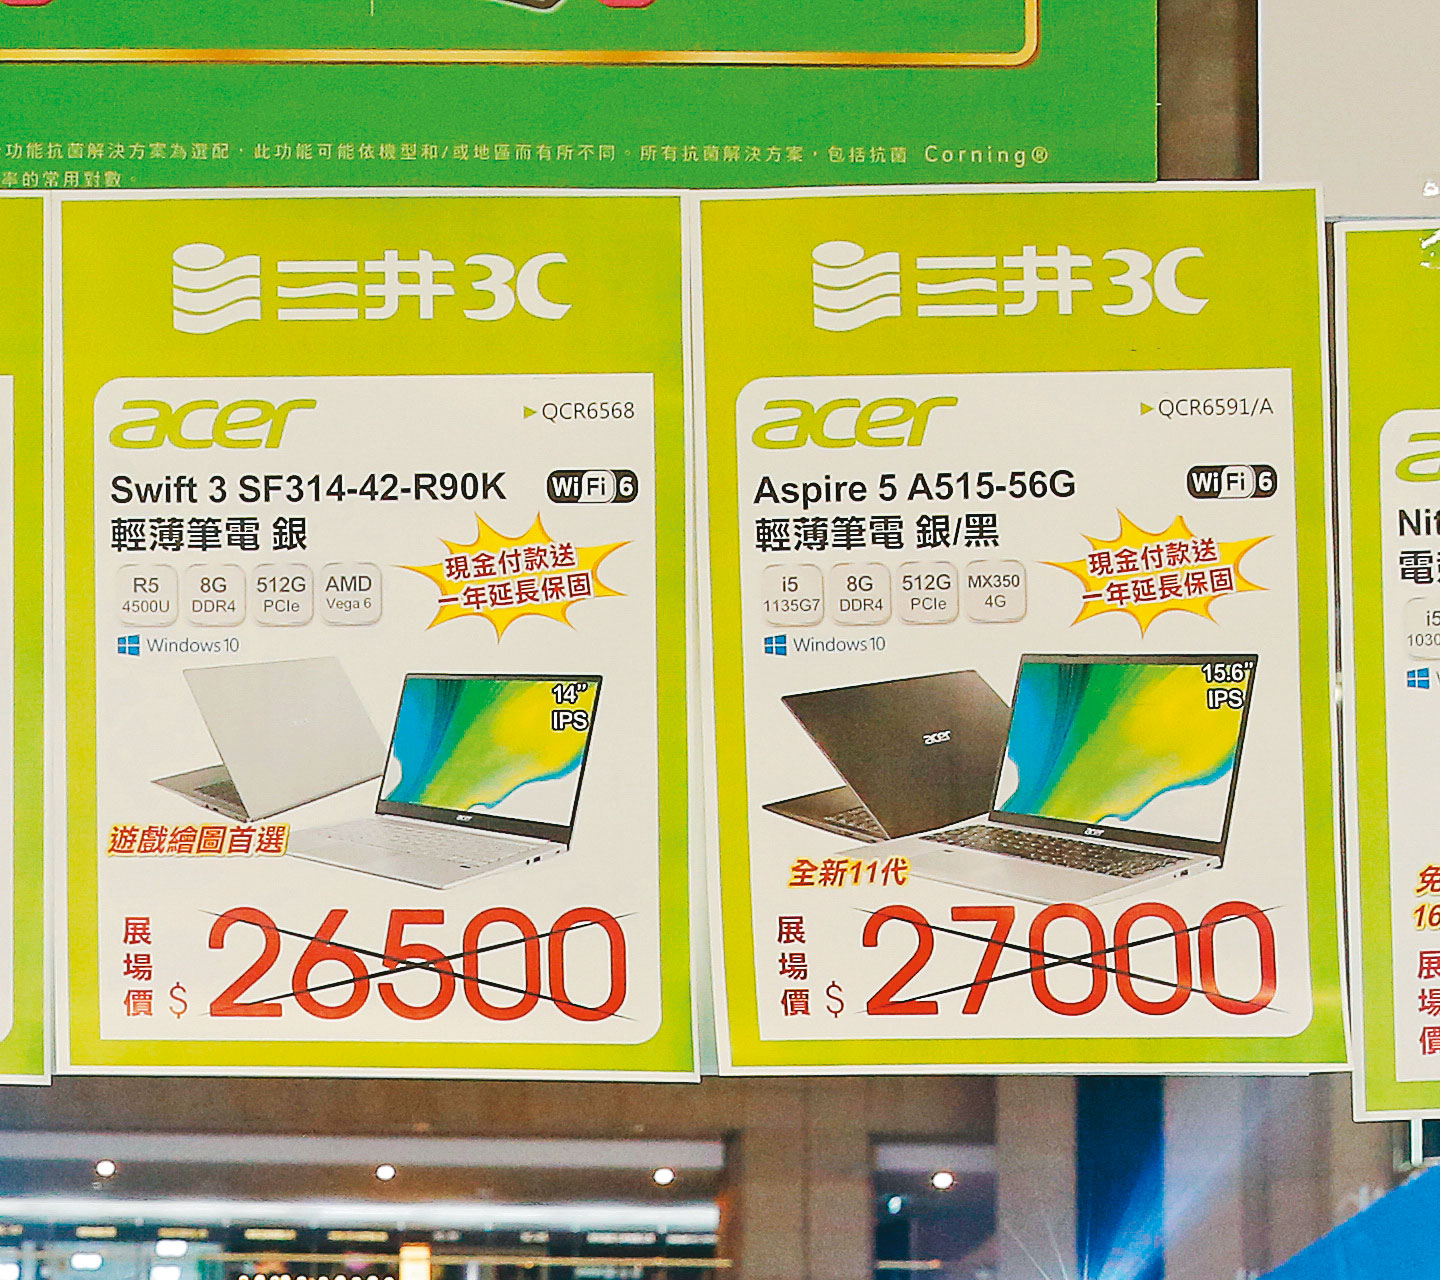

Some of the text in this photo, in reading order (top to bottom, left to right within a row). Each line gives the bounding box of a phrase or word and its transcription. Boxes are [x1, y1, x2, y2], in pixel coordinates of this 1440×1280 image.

[277, 248, 572, 322] 三井3C
[916, 244, 1210, 318] 三井3C
[108, 398, 317, 449] acer
[542, 401, 636, 422] QCR6568
[751, 396, 958, 449] acer
[1158, 398, 1274, 418] QCR6591/A
[110, 472, 507, 504] Swift 3 SF314-42-R90K
[753, 470, 1076, 510] Aspire 5 A515-56G
[110, 517, 308, 552] 輕薄筆電 銀
[754, 513, 1000, 552] 輕薄筆電 銀/黑
[445, 544, 576, 582] 現金付款送
[132, 576, 160, 594] R5
[200, 576, 228, 594] 8G
[256, 576, 306, 594] 512G
[326, 576, 372, 592] AMD
[438, 572, 592, 612] 一年延長保固
[122, 598, 170, 614] 4500U
[191, 598, 236, 614] DDR4
[264, 598, 300, 614] PCIe
[326, 597, 372, 612] Vega 6
[922, 729, 952, 746] acer
[108, 826, 287, 856] 遊戲繪圖首選
[788, 857, 908, 888] 全新11代
[122, 916, 153, 1019] 展場價
[208, 906, 627, 1022] 26500
[777, 916, 810, 1018] 展場價
